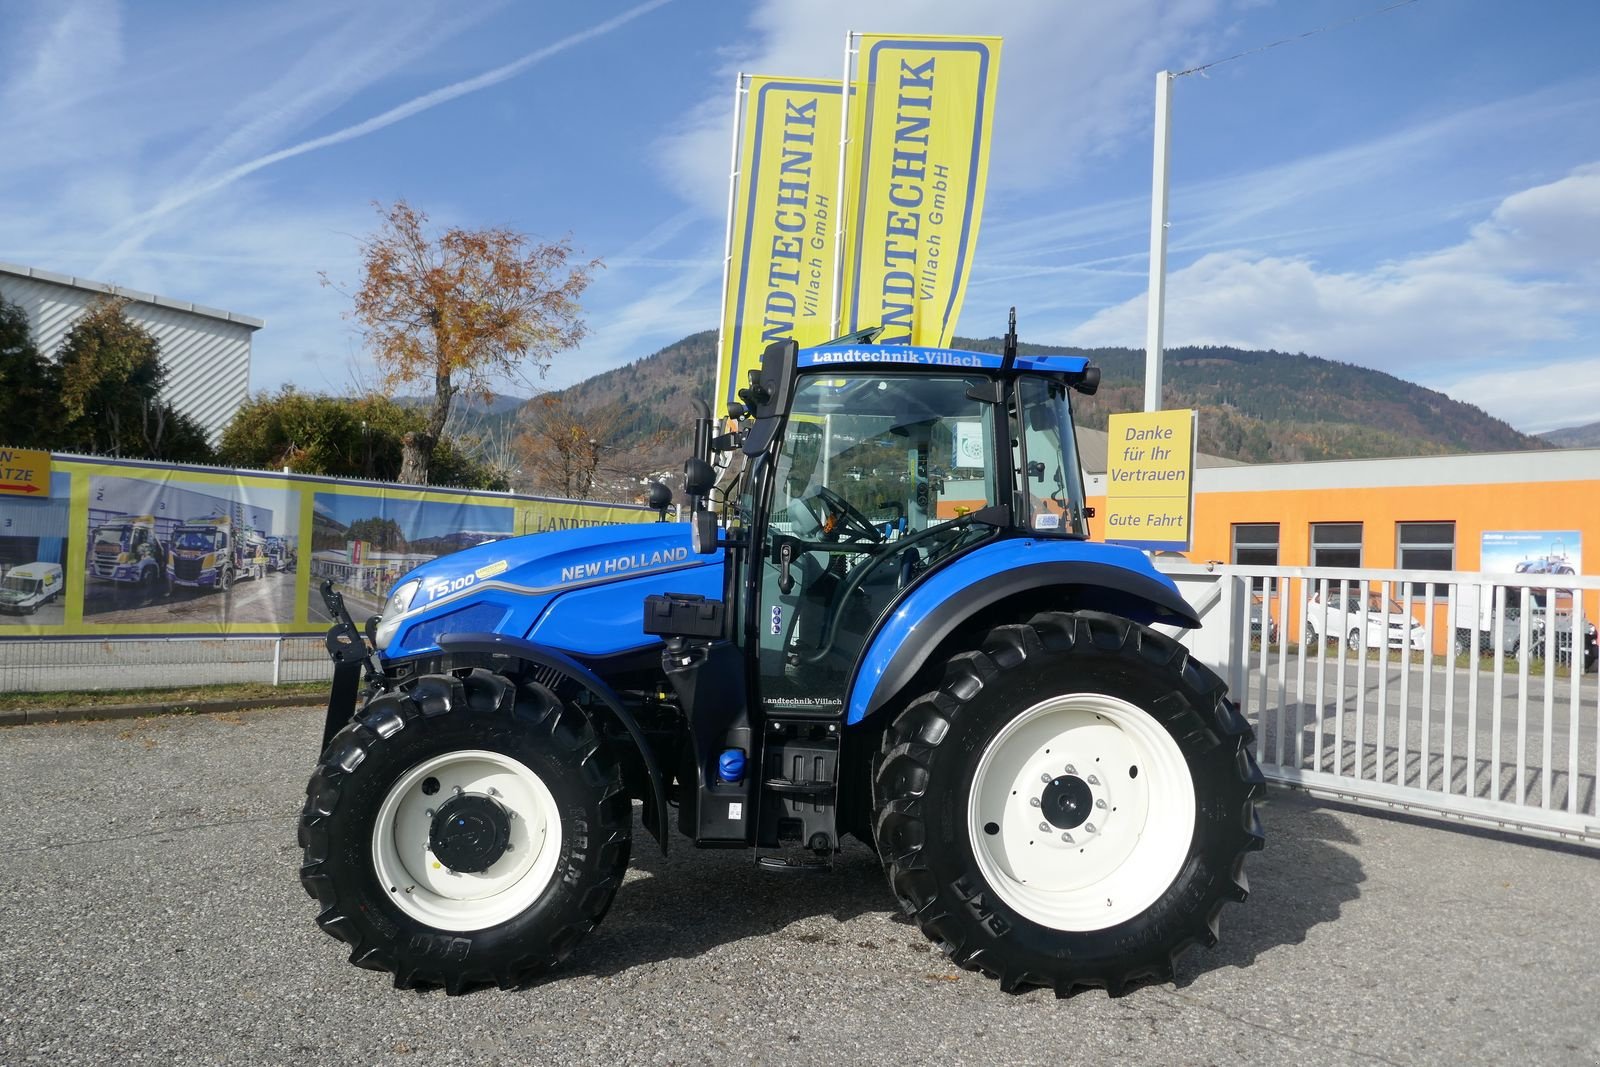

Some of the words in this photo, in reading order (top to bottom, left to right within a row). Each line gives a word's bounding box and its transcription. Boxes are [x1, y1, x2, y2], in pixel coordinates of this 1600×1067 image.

[929, 164, 950, 225] GmbH
[760, 97, 818, 347] NDTECHNIK
[811, 194, 829, 251] GmbH
[802, 254, 822, 318] Villach
[919, 237, 941, 302] Villach
[812, 349, 983, 367] Landtechnik-Villach
[1123, 447, 1145, 462] für
[1151, 446, 1171, 460] Ihr
[1126, 426, 1173, 441] Danke
[1111, 467, 1185, 482] Vertrauen
[1108, 513, 1141, 527] Gute
[1146, 513, 1183, 528] Fahrt
[562, 562, 601, 581] NEW
[605, 547, 687, 573] HOLLAND
[950, 876, 1013, 939] BKT
